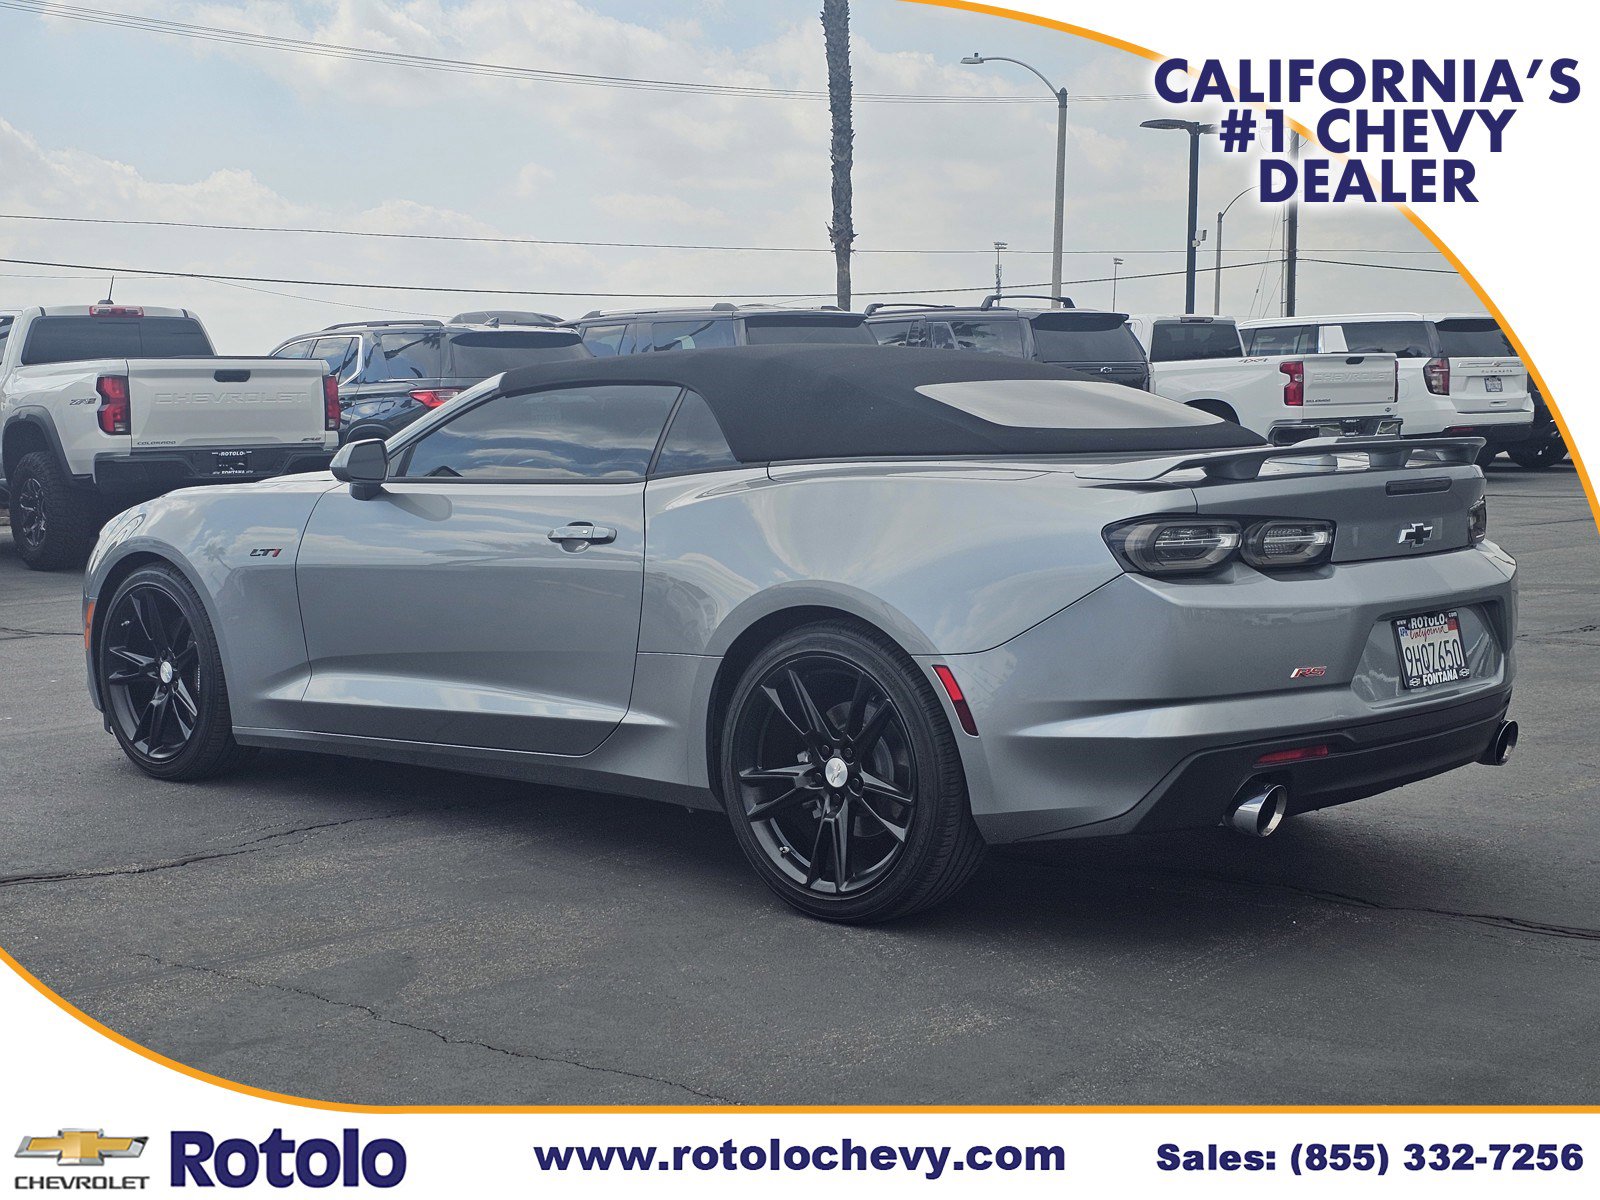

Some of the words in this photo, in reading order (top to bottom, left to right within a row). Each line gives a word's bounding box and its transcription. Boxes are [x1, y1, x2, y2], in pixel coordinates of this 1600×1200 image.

[155, 391, 308, 405] CHEVROLET
[1410, 613, 1445, 630] ROTOLO
[1409, 625, 1449, 642] California
[1290, 665, 1328, 679] RS
[1422, 668, 1459, 686] FONTANA
